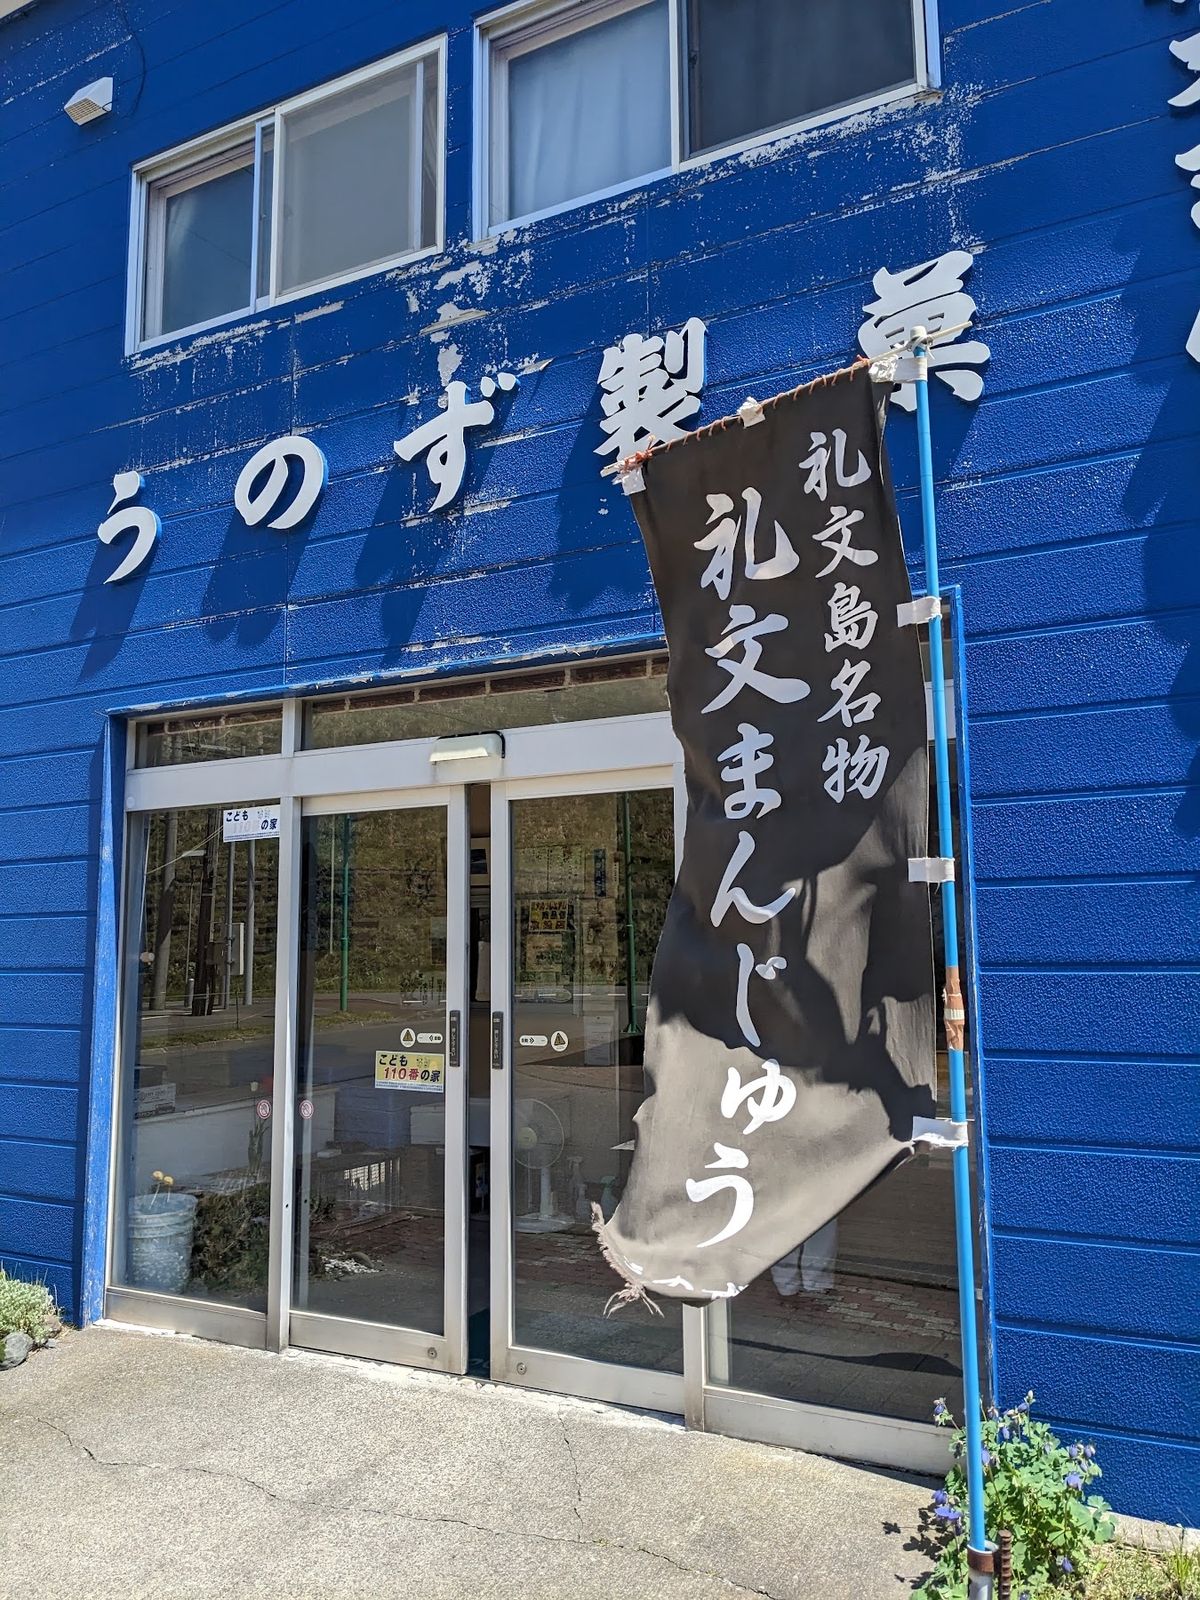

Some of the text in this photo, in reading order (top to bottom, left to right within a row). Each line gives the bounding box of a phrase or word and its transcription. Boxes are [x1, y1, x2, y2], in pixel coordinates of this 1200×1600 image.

[799, 429, 889, 803] 礼文島名物
[226, 810, 249, 822] こども
[685, 487, 811, 1249] 礼文まんじゅう
[379, 1054, 408, 1067] こども
[384, 1067, 441, 1082] 110番の家
